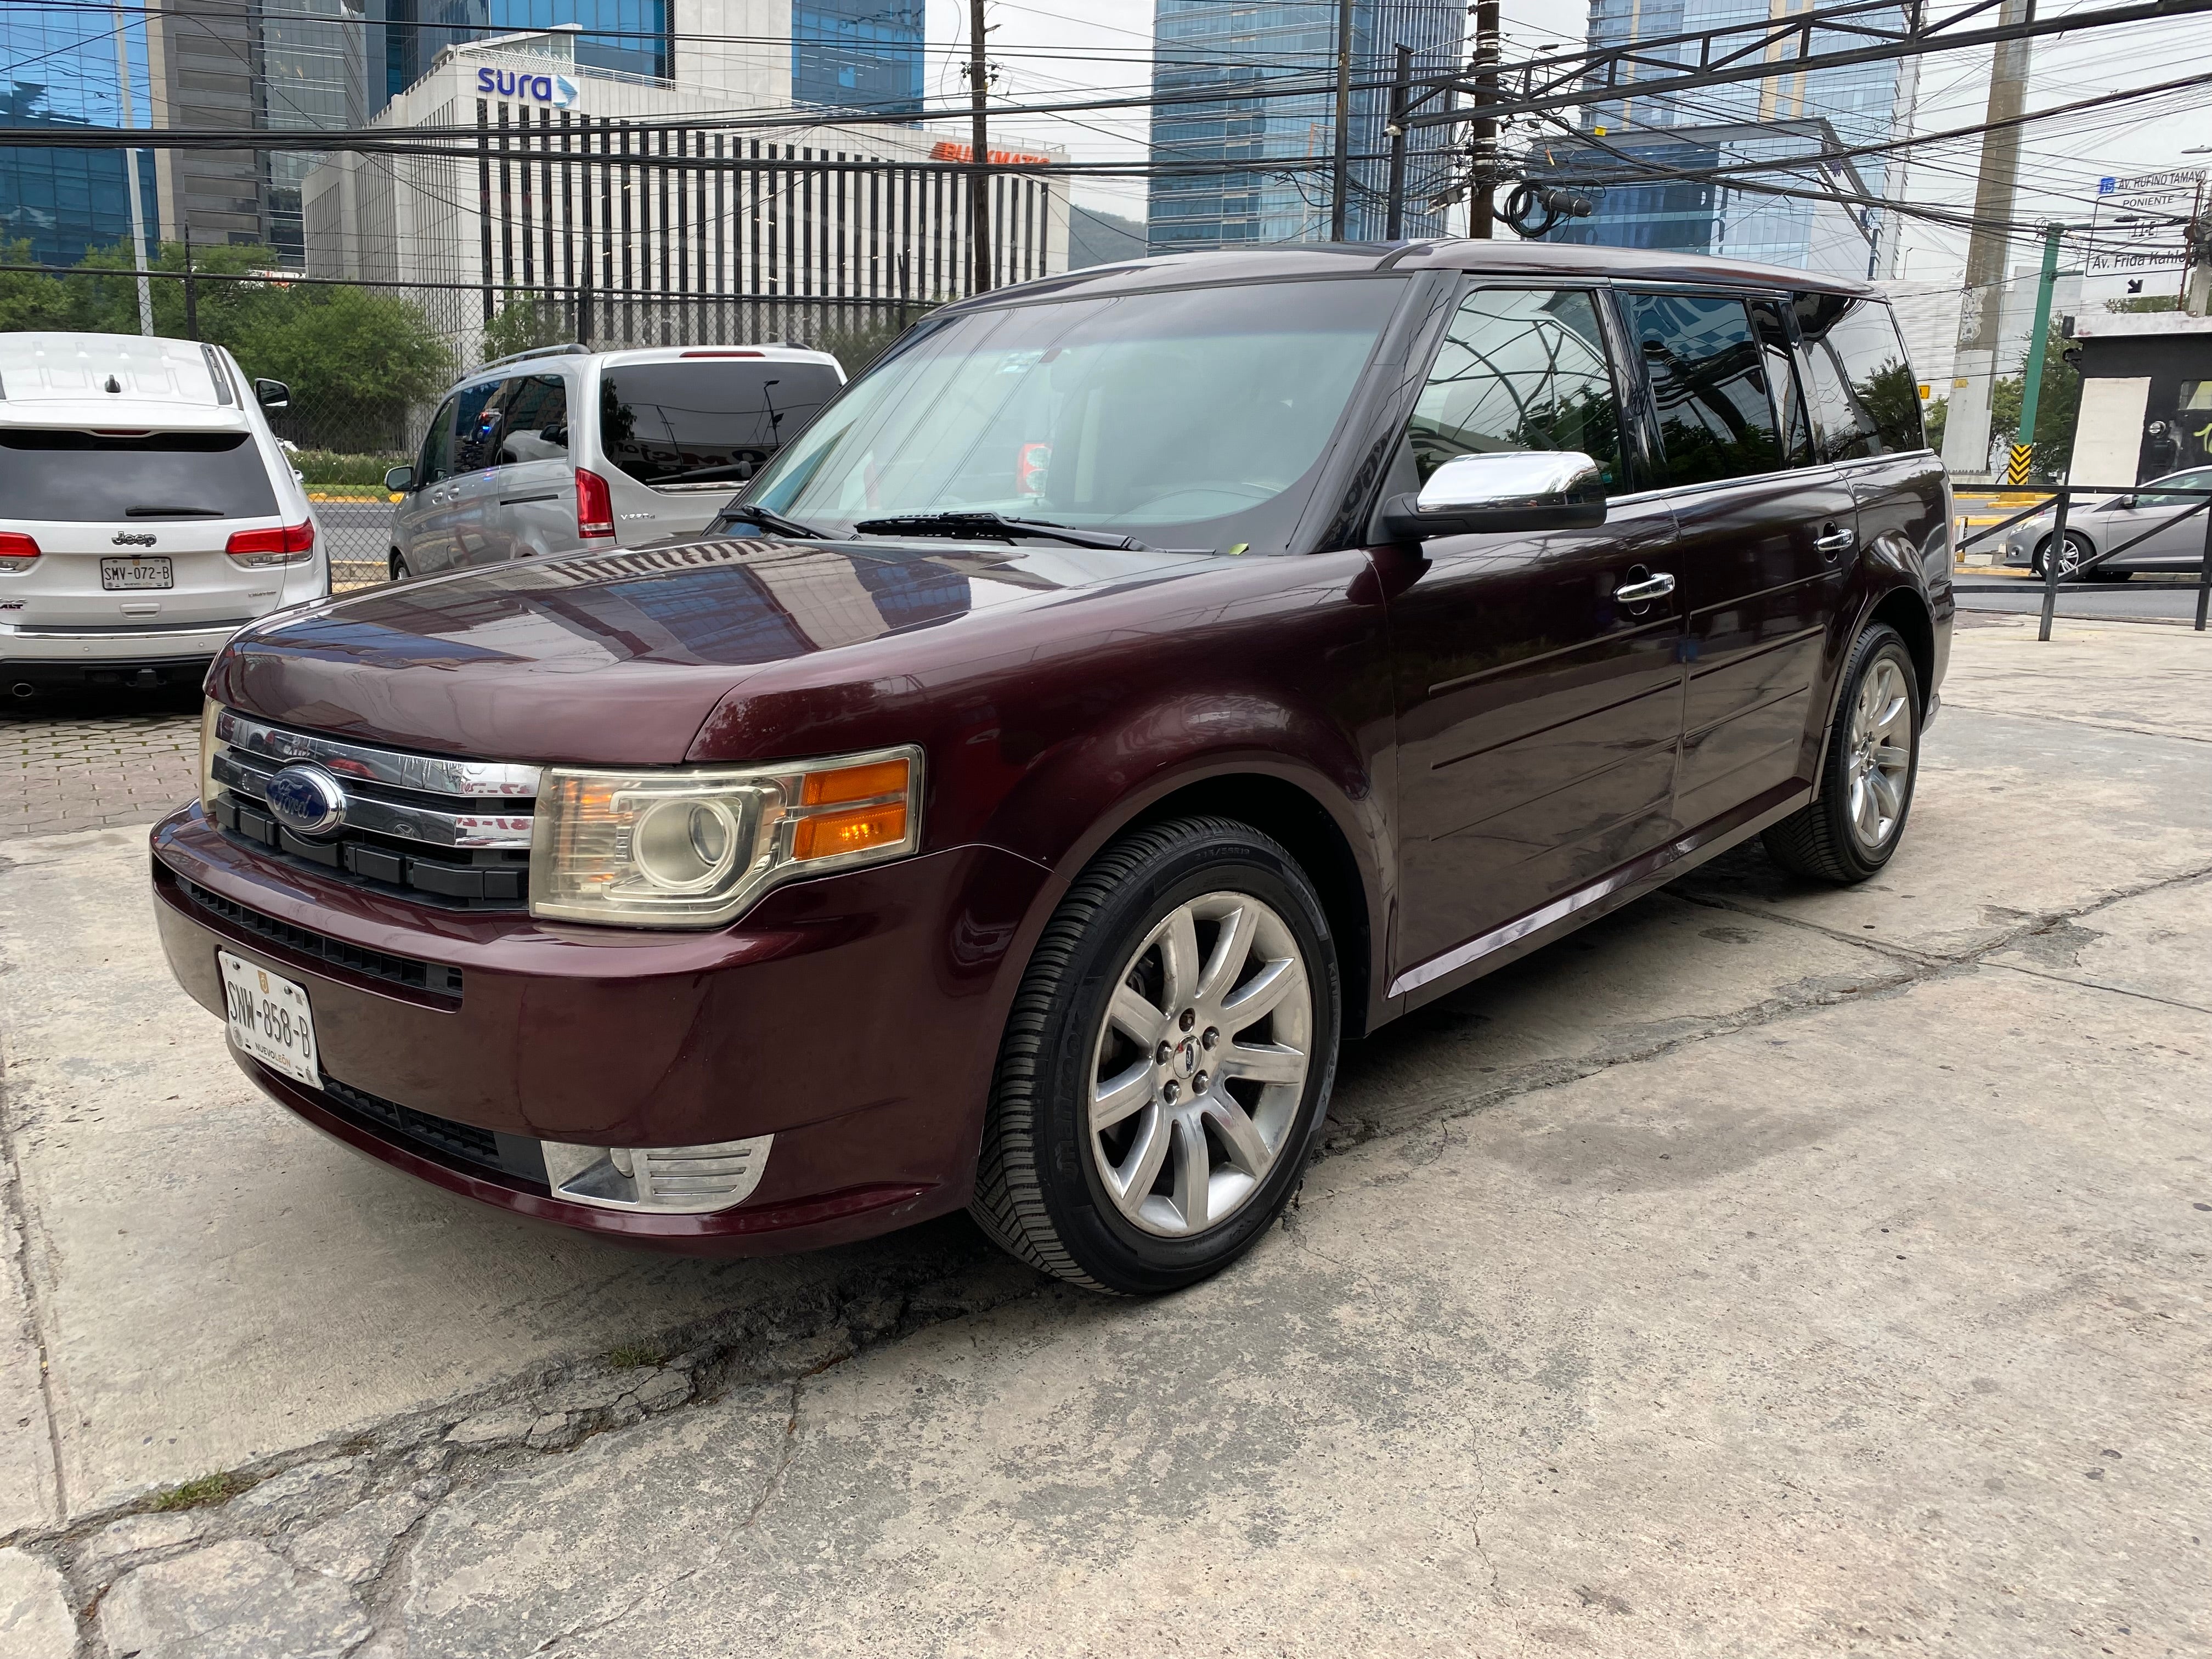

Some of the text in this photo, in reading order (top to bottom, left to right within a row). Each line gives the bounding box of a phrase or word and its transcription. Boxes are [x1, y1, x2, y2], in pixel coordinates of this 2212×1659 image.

[478, 67, 552, 101] sura
[2118, 178, 2131, 189] AV.
[2134, 174, 2167, 189] RUFINO
[2170, 170, 2207, 184] TAMAYO
[2123, 195, 2174, 207] PONIENTE
[2092, 257, 2110, 269] Av.
[2114, 253, 2145, 268] Frida
[111, 531, 157, 548] Jeep
[104, 566, 170, 580] SMV-072-B
[274, 778, 312, 819] Ford
[228, 980, 311, 1058] SNW-858-B
